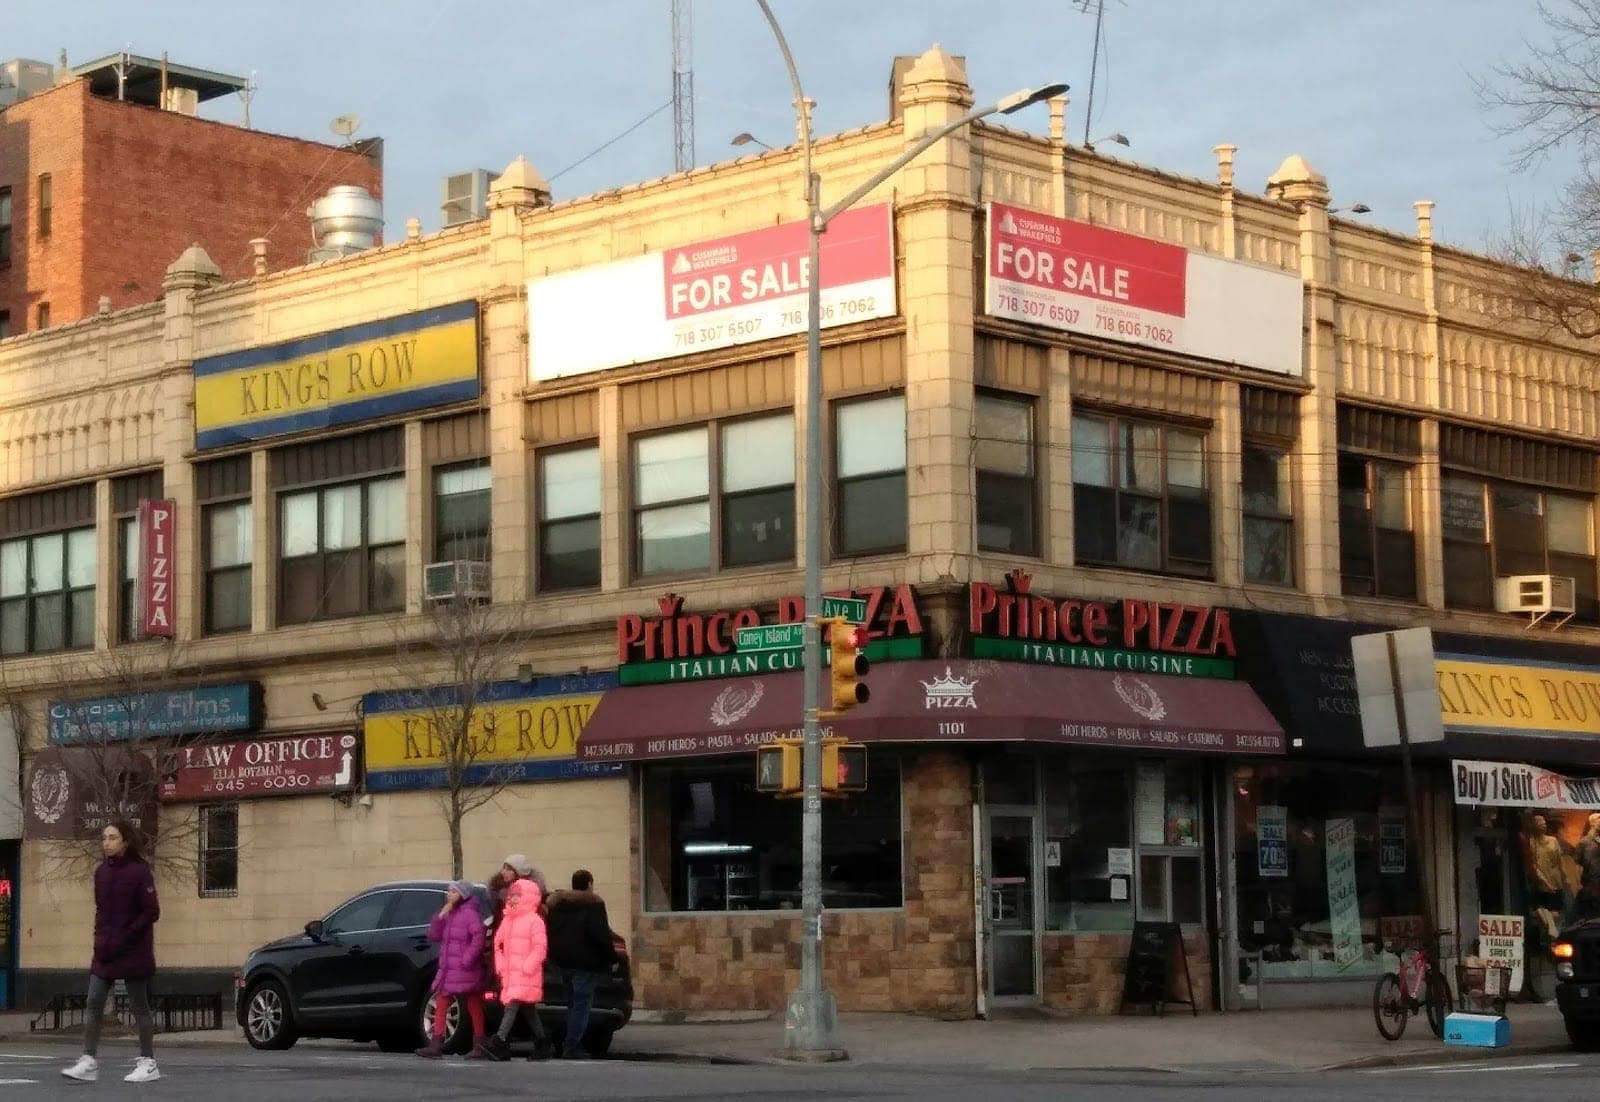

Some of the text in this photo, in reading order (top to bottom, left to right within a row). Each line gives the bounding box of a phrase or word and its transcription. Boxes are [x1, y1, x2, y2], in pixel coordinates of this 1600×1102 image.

[1019, 229, 1061, 245] WAKEFIELD
[692, 254, 738, 271] WAKEFIELD
[998, 242, 1130, 300] FOR SALE
[672, 257, 810, 314] FOR SALE
[781, 311, 802, 327] 718
[840, 296, 876, 315] 7062
[998, 295, 1017, 312] 718
[1023, 299, 1045, 317] 307
[1049, 305, 1080, 325] 6507
[675, 318, 762, 347] 718 307 6507
[1096, 314, 1173, 344] 718 606 7062
[240, 339, 417, 416] KINGS ROW
[150, 509, 168, 626] PIZZA
[617, 584, 922, 661] Prince PZA
[825, 600, 864, 620] Ave U
[969, 568, 1238, 656] Prince PIZZA
[739, 632, 763, 648] Coney
[765, 626, 791, 643] Island
[669, 653, 758, 679] ITALIAN
[1024, 644, 1193, 675] ITALIAN CUISINE
[167, 691, 232, 717] Films
[926, 696, 977, 709] PIZZA
[1437, 671, 1534, 718] KINGS
[516, 704, 591, 751] ROW
[648, 726, 834, 753] HOT HEROS PASTA SALADS CATNG
[938, 722, 965, 735] 1101
[1061, 724, 1224, 746] HOT HEROS PASTA SALADS CATERING
[185, 745, 235, 769] LAW
[245, 736, 334, 764] OFFICE
[215, 779, 245, 791] 645
[263, 774, 310, 788] 6030
[1457, 765, 1488, 802] Buy
[1491, 767, 1498, 799] 1
[1501, 767, 1534, 800] Suit
[1479, 919, 1522, 937] SALE
[1486, 938, 1514, 947] ITALIAN
[1489, 948, 1514, 957] SHOES
